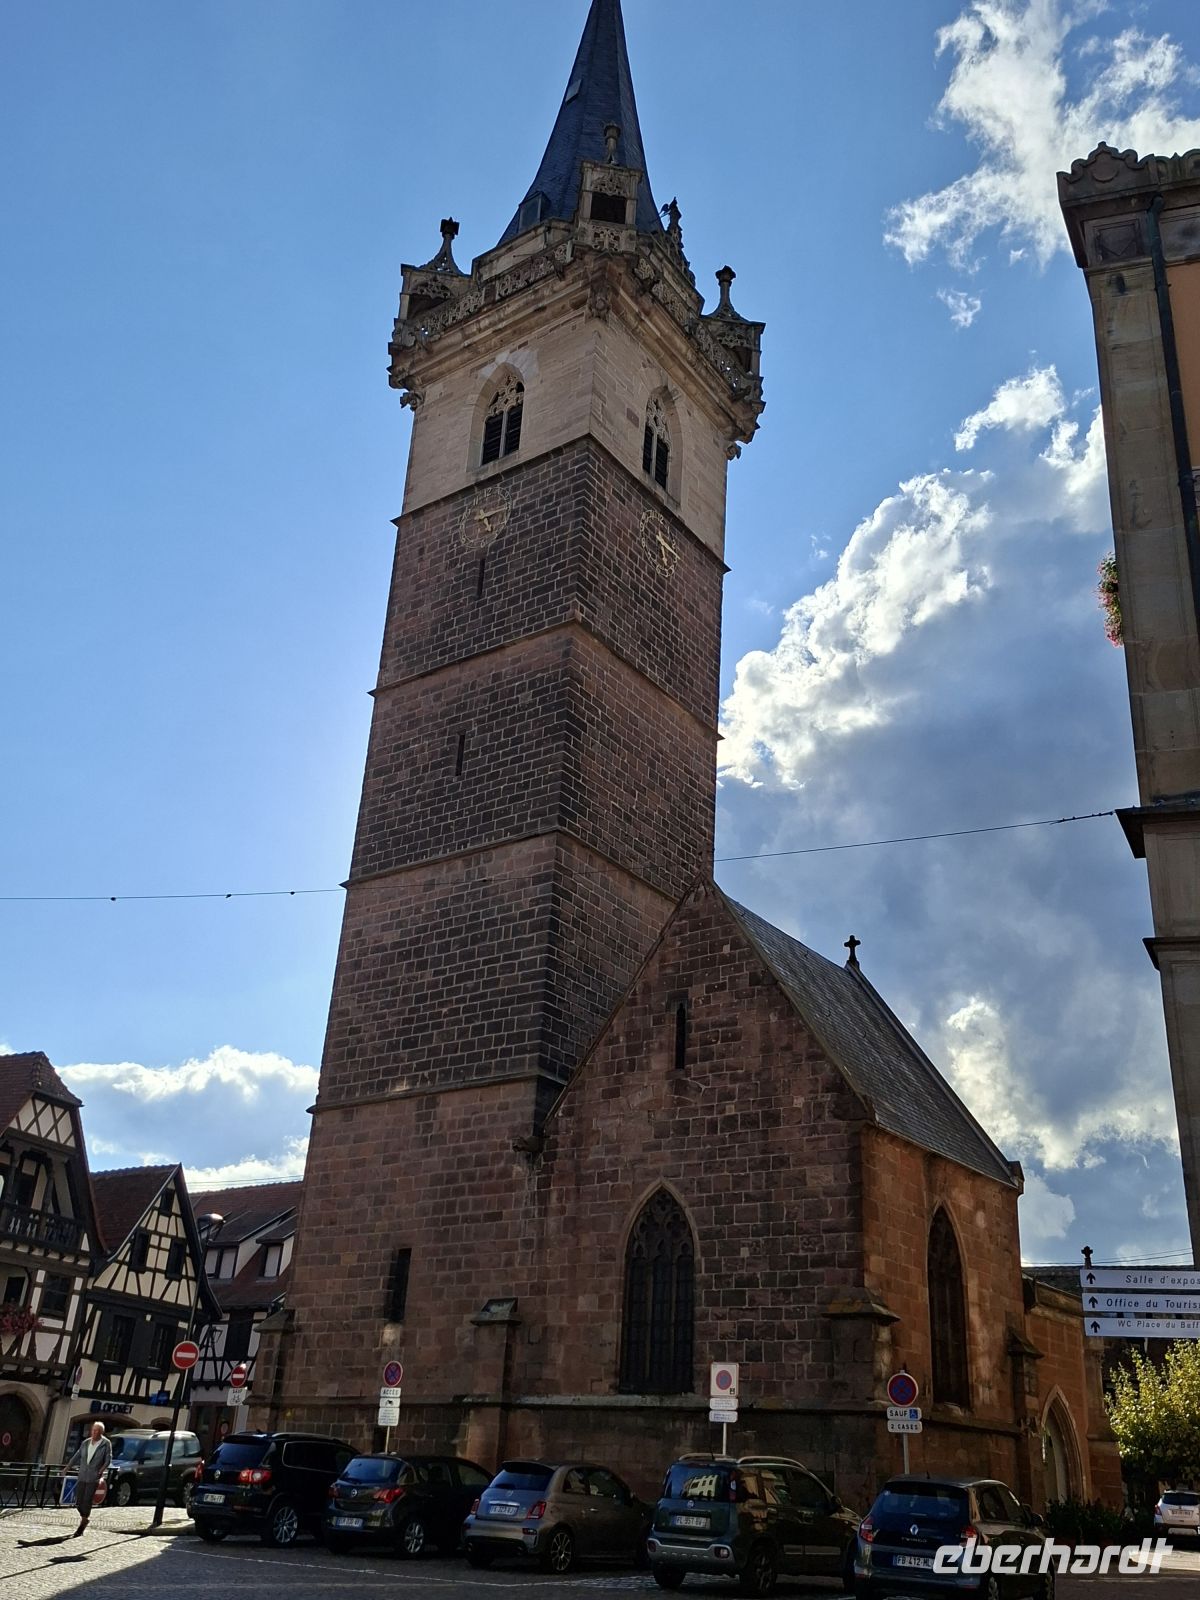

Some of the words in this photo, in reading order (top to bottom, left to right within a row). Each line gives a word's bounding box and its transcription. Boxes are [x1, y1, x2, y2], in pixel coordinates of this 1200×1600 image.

[1125, 1274, 1154, 1285] Salle
[1106, 1298, 1140, 1308] Office
[1145, 1299, 1159, 1309] du
[1165, 1299, 1200, 1310] Touris
[1117, 1319, 1133, 1328] WC
[1136, 1320, 1161, 1329] Place
[1165, 1321, 1176, 1329] du
[889, 1409, 908, 1417] SAUF
[897, 1423, 918, 1431] CASES
